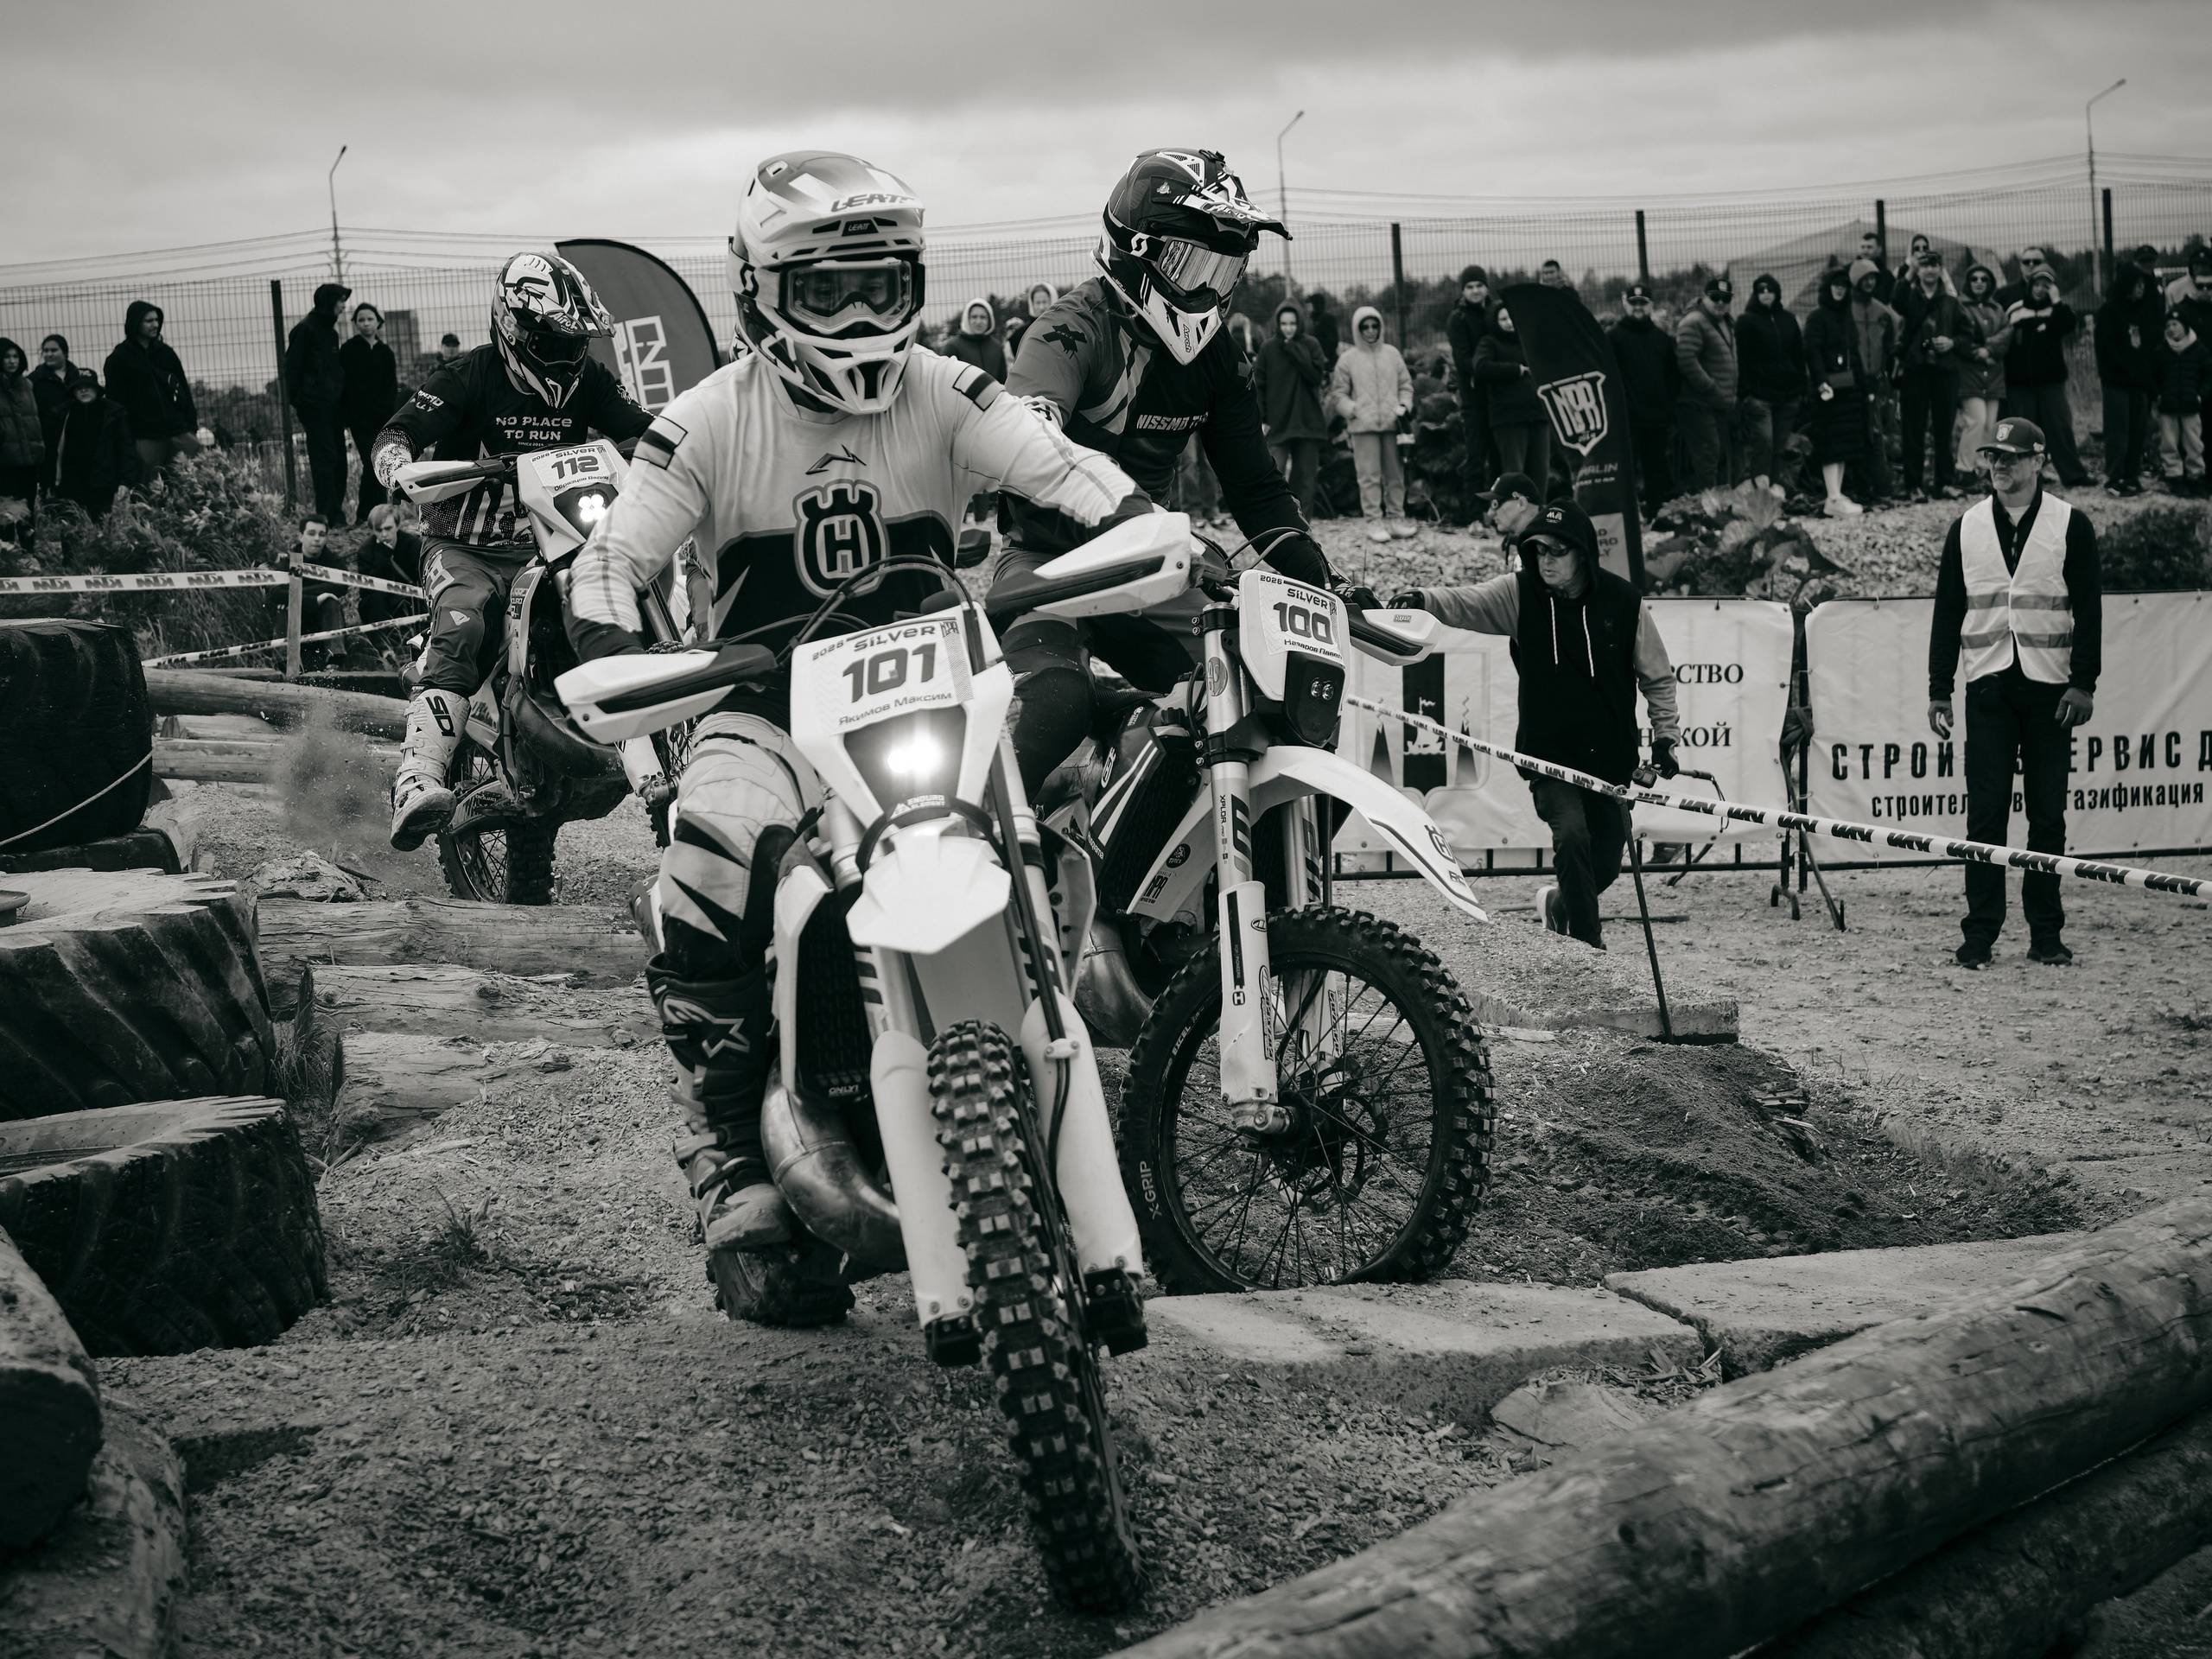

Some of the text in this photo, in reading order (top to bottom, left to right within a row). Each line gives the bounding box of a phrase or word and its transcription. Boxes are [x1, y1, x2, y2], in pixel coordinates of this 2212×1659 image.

[495, 416, 518, 426] NO
[503, 429, 562, 442] TO RUN
[551, 455, 599, 480] 112
[1273, 601, 1334, 645] 100
[842, 642, 937, 703] 101
[1671, 664, 1744, 683] СТВО
[839, 691, 953, 726] Якимов Максим
[2066, 782, 2203, 812] азификация
[1172, 1025, 1192, 1056] EXCEL
[1140, 1160, 1163, 1220] X-GRIP
